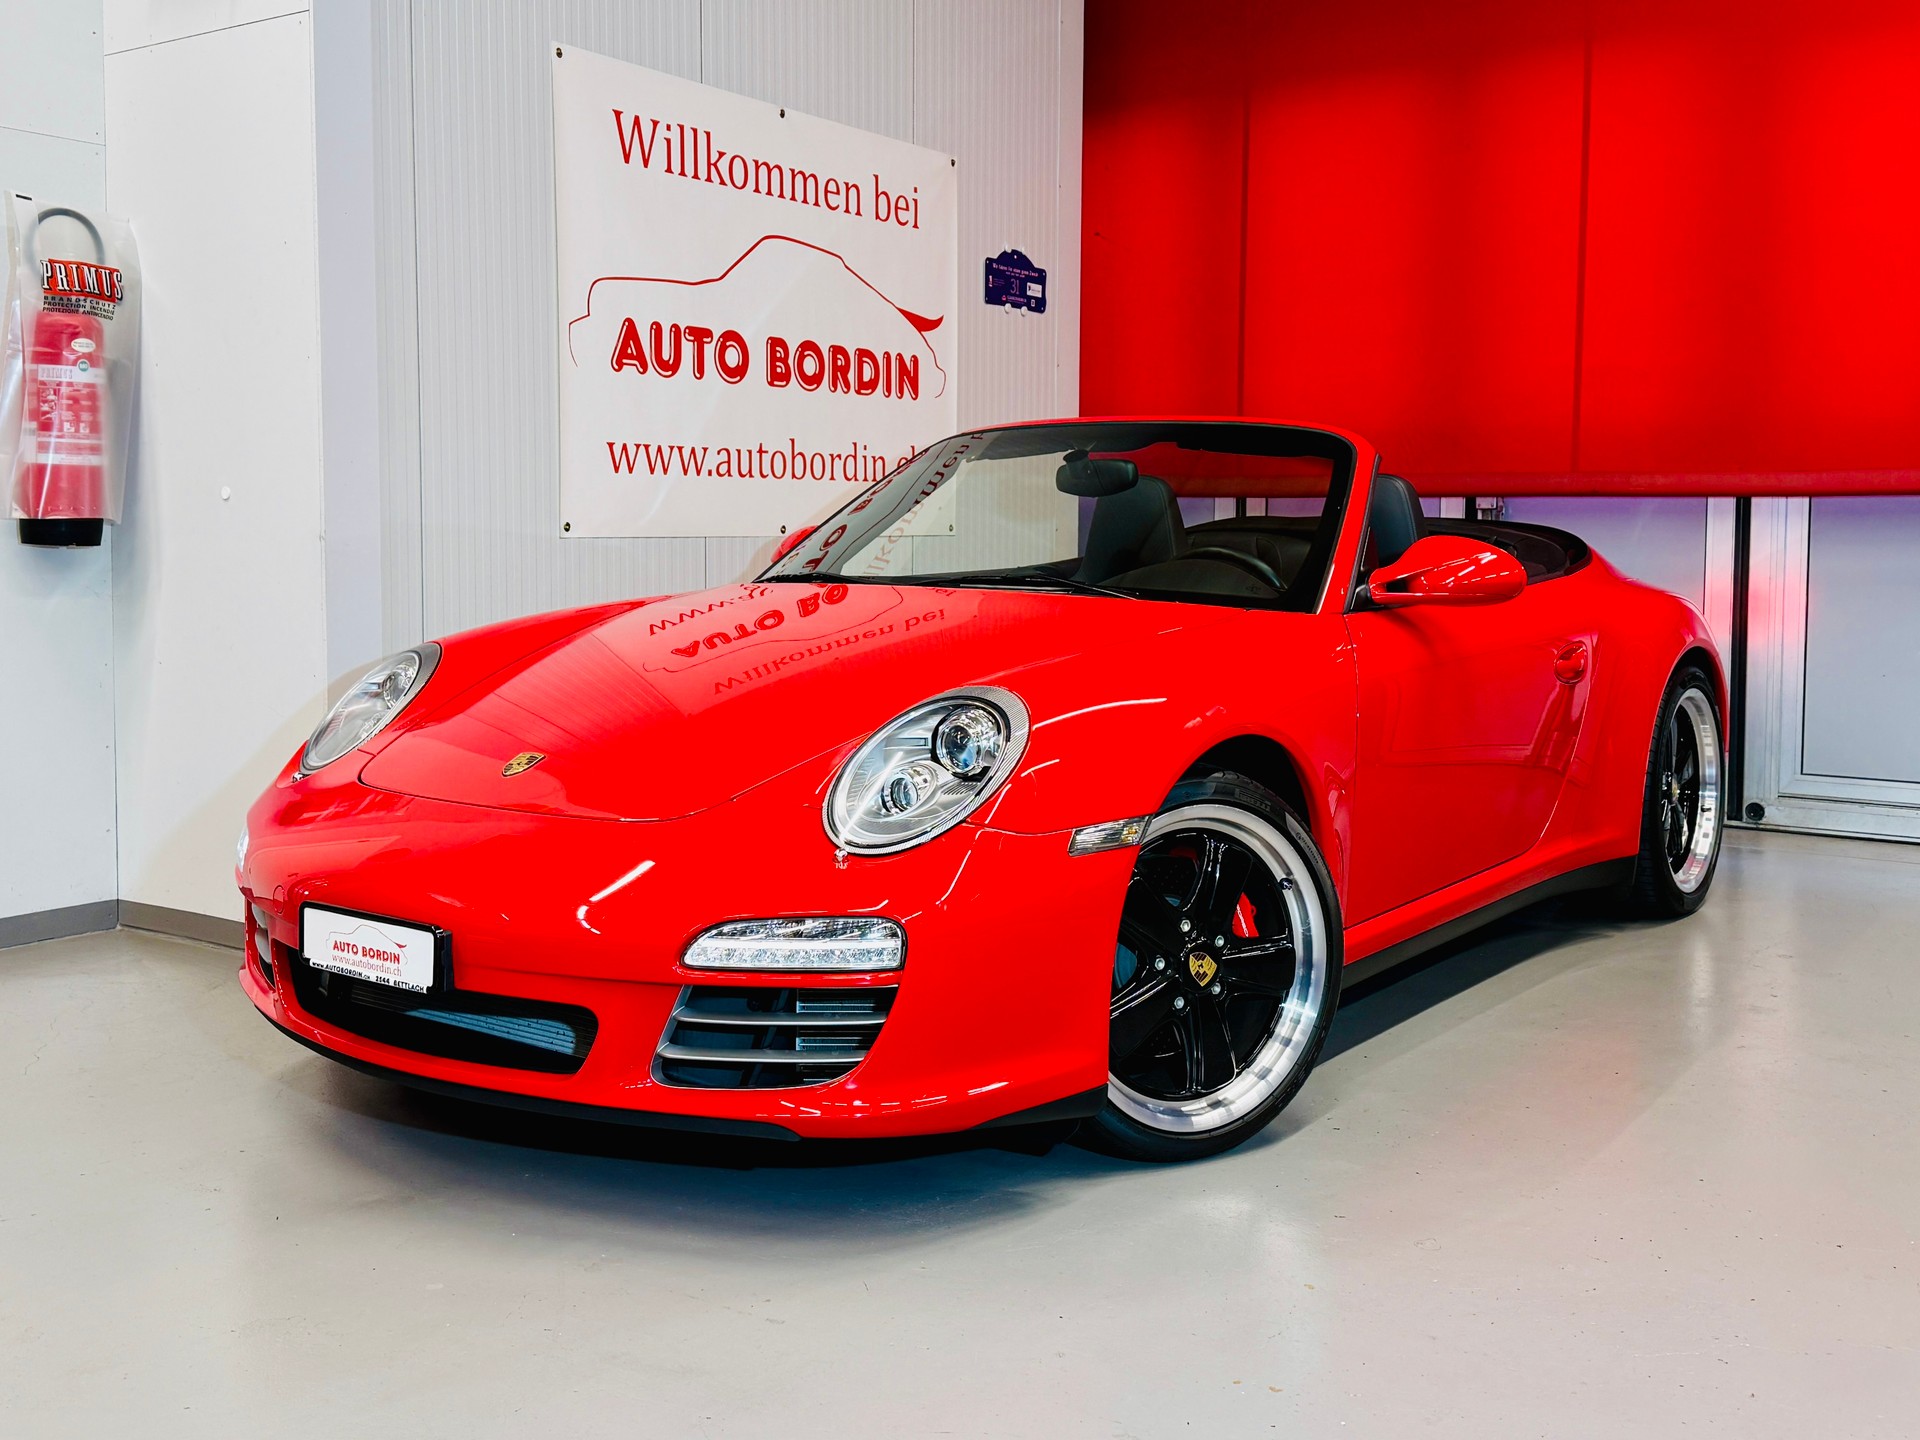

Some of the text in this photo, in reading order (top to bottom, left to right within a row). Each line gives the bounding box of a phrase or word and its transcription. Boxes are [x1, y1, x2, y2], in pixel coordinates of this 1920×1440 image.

[611, 108, 920, 230] Willkommen bei
[40, 260, 124, 301] PRIMUS
[42, 307, 81, 315] PROTEZIONE
[43, 295, 116, 310] BRANDSCHUTZ
[43, 301, 115, 316] PROTECTION INCENDIE
[610, 317, 920, 401] AUTO BORDIN
[332, 939, 401, 966] AUTO BORDIN
[331, 954, 402, 977] www.autobordin.ch
[393, 979, 425, 992] BETTLACH
